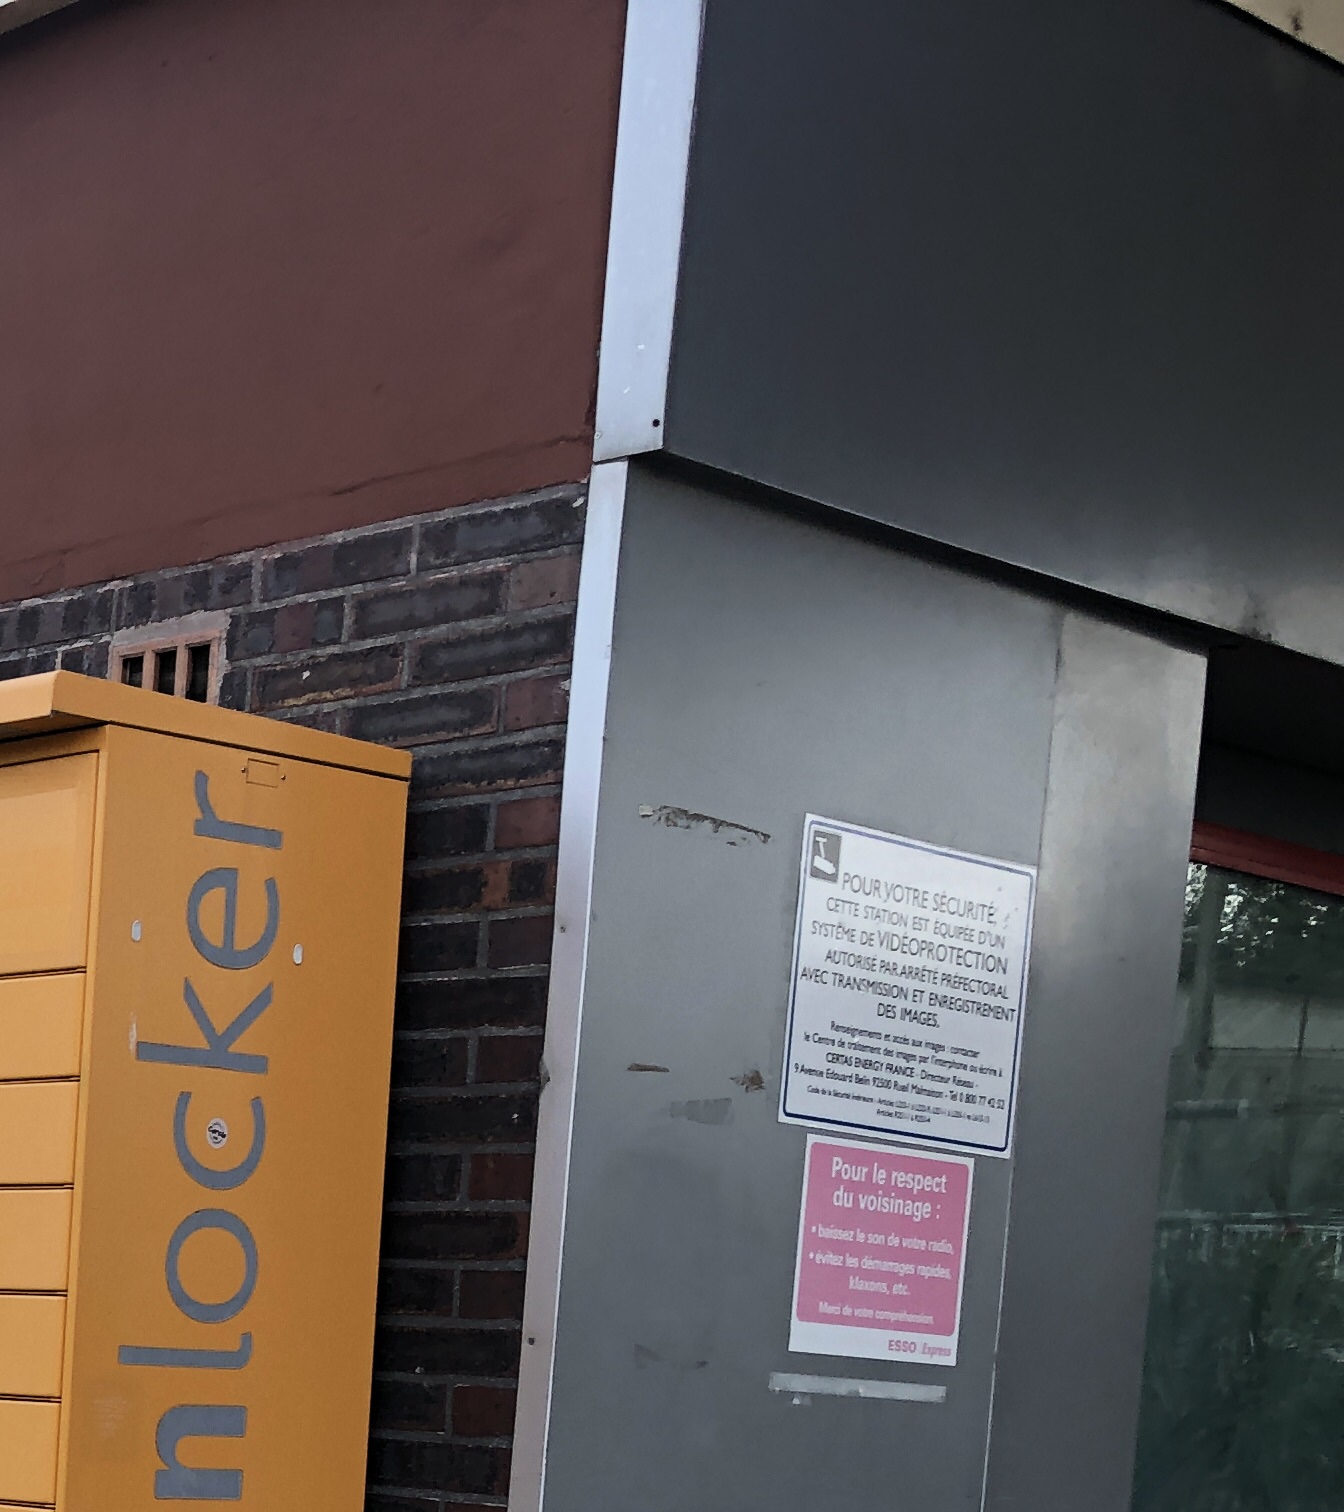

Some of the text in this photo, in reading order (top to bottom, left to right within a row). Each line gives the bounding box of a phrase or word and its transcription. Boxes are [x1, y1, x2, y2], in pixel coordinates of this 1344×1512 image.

[842, 872, 996, 924] POUR VOTRE SÉCURITÉ,
[826, 897, 1005, 949] CETTE STATION EST ÉQUIPÉE D'UN
[859, 930, 875, 947] DE
[878, 931, 1007, 974] VIDÉOPROTECTION
[824, 949, 876, 971] AUTORISÉ
[878, 959, 898, 976] PAR
[940, 972, 1008, 999] PRÉFECTORAL
[800, 966, 1015, 1021] AVEC TRANSMISSION ET ENREGISTREMENT
[876, 1002, 896, 1019] DES
[885, 1062, 914, 1077] FRANCE
[831, 1156, 946, 1193] Pour le respect
[832, 1185, 853, 1207] du
[858, 1190, 930, 1221] voisinage
[855, 1228, 864, 1242] le
[867, 1233, 884, 1244] son
[887, 1232, 899, 1246] de
[845, 1253, 858, 1267] les
[888, 1339, 916, 1353] ESSO
